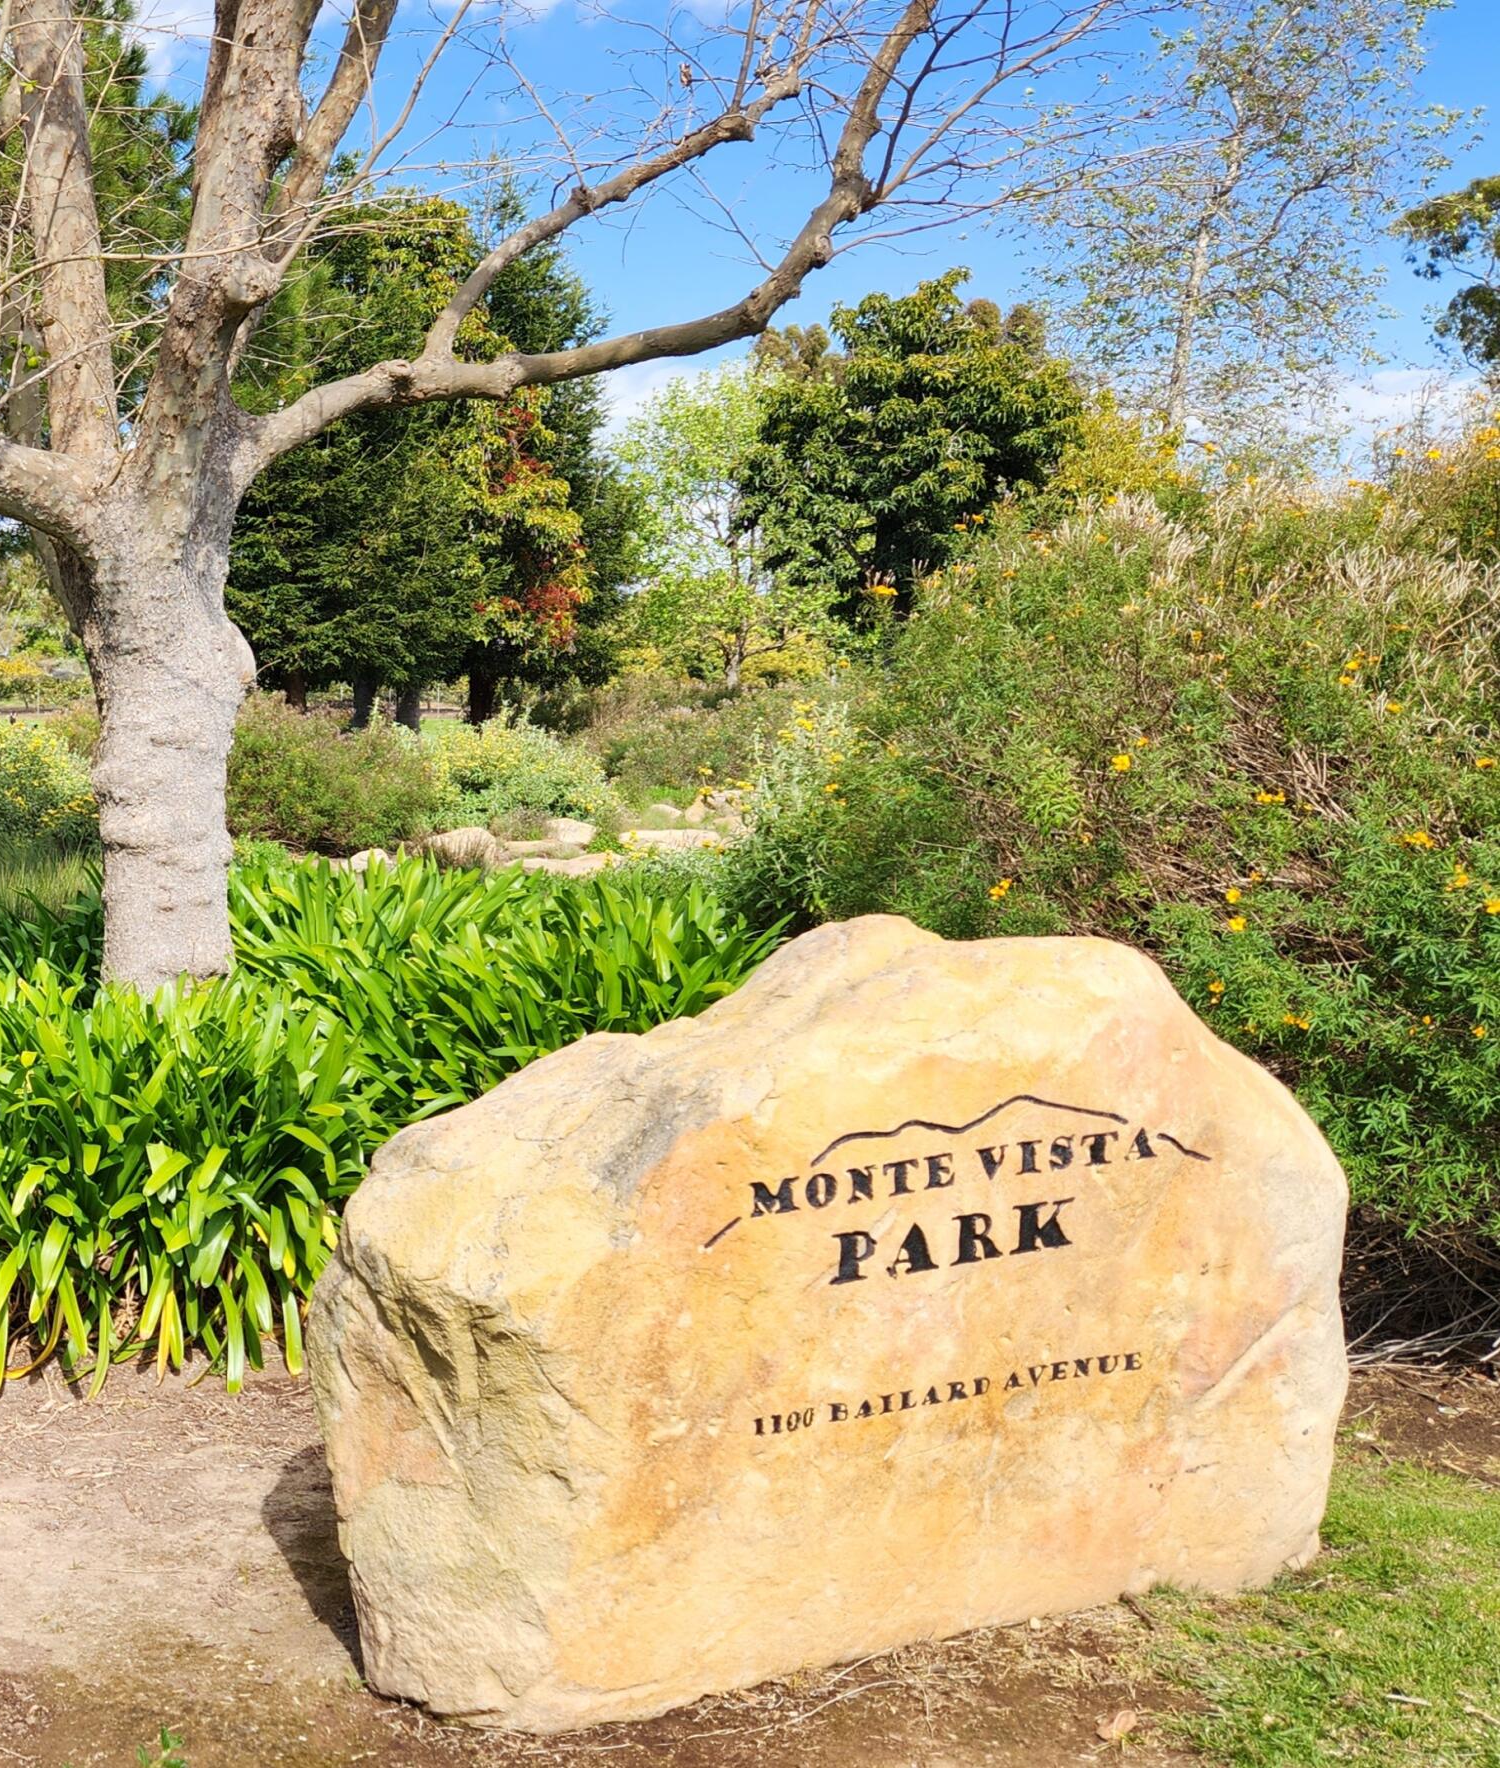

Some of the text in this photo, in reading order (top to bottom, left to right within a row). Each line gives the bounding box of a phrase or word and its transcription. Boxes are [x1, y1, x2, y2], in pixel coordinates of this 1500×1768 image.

[749, 1127, 1158, 1218] MONTE VISTA
[829, 1196, 1076, 1286] PARK
[753, 1351, 1144, 1437] 1100 BAILARD AVENUE
